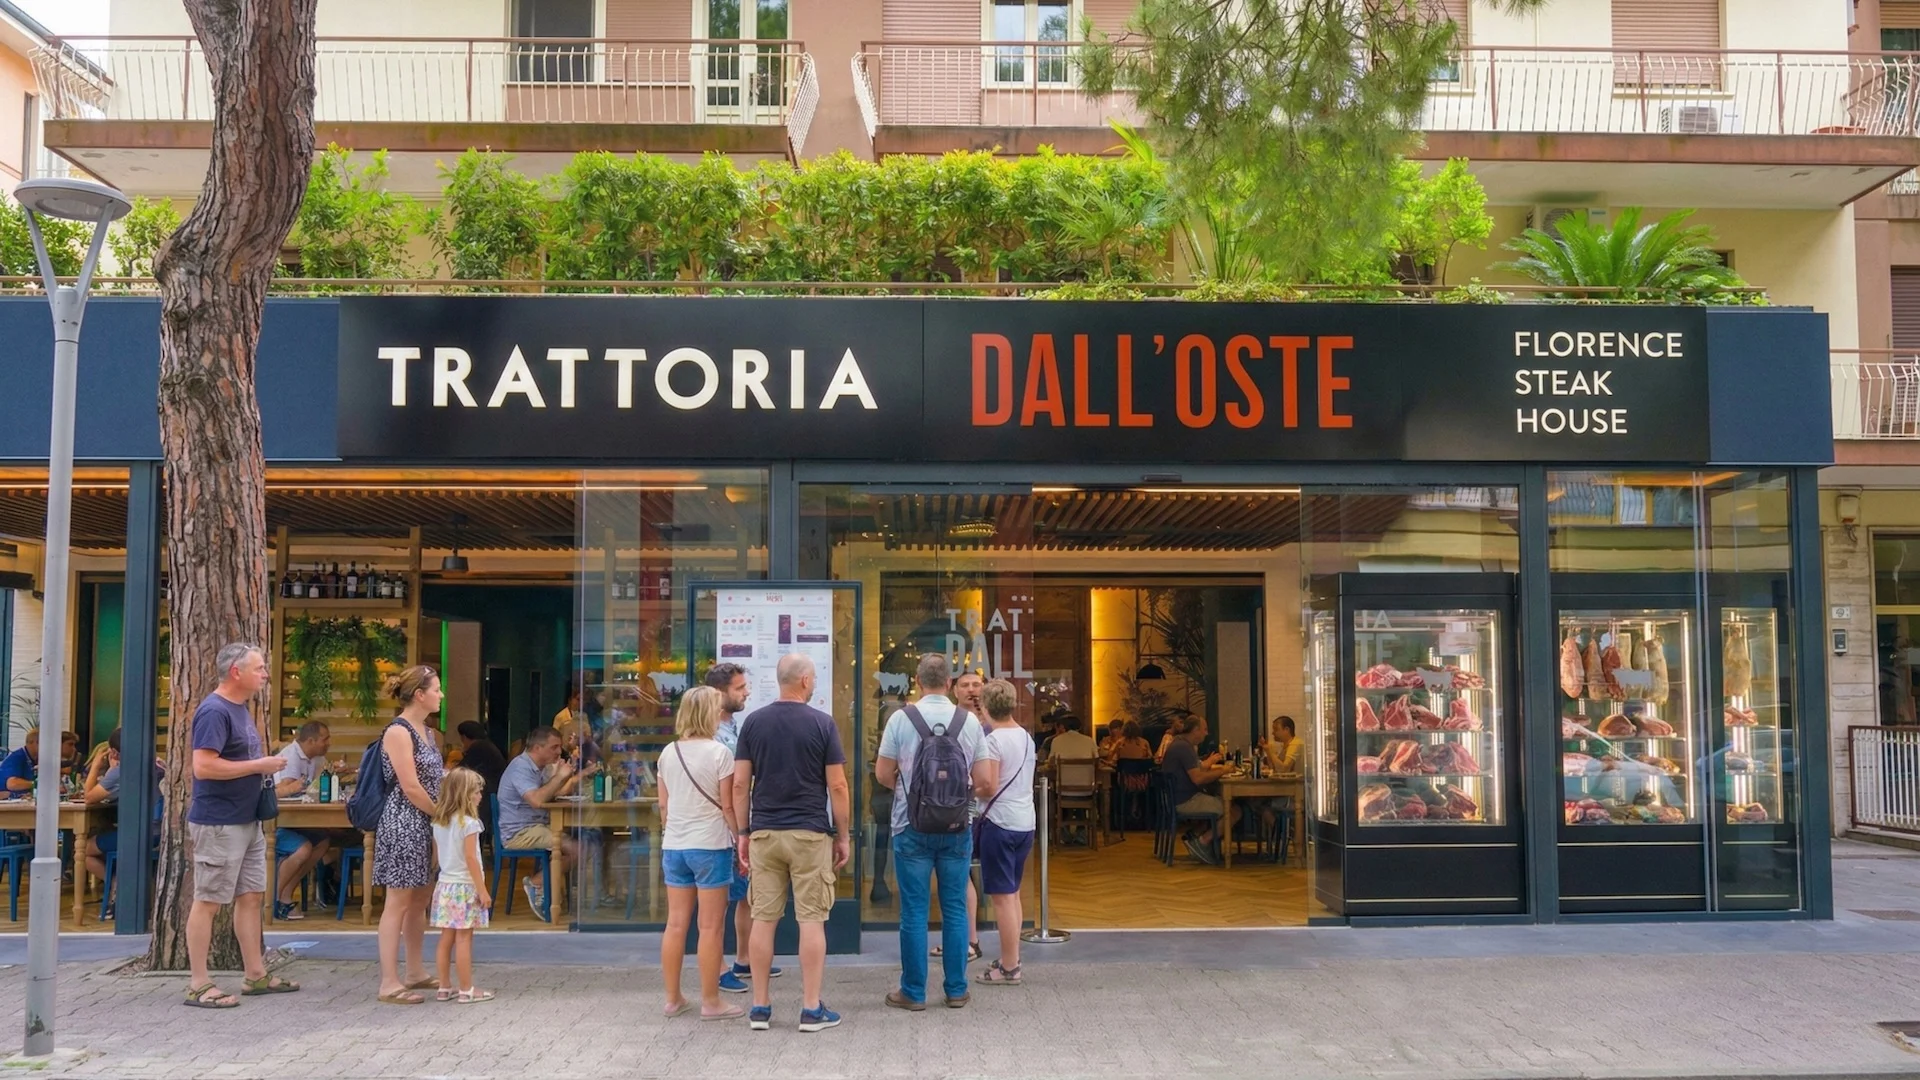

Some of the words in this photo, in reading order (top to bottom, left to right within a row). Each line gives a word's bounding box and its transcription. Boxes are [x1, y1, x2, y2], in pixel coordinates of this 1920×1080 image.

[1513, 330, 1685, 359] FLORENCE
[377, 343, 880, 411] TRATTORIA
[970, 333, 1354, 430] DALL'OSTE
[1514, 369, 1614, 397] STEAK
[1516, 406, 1629, 436] HOUSE
